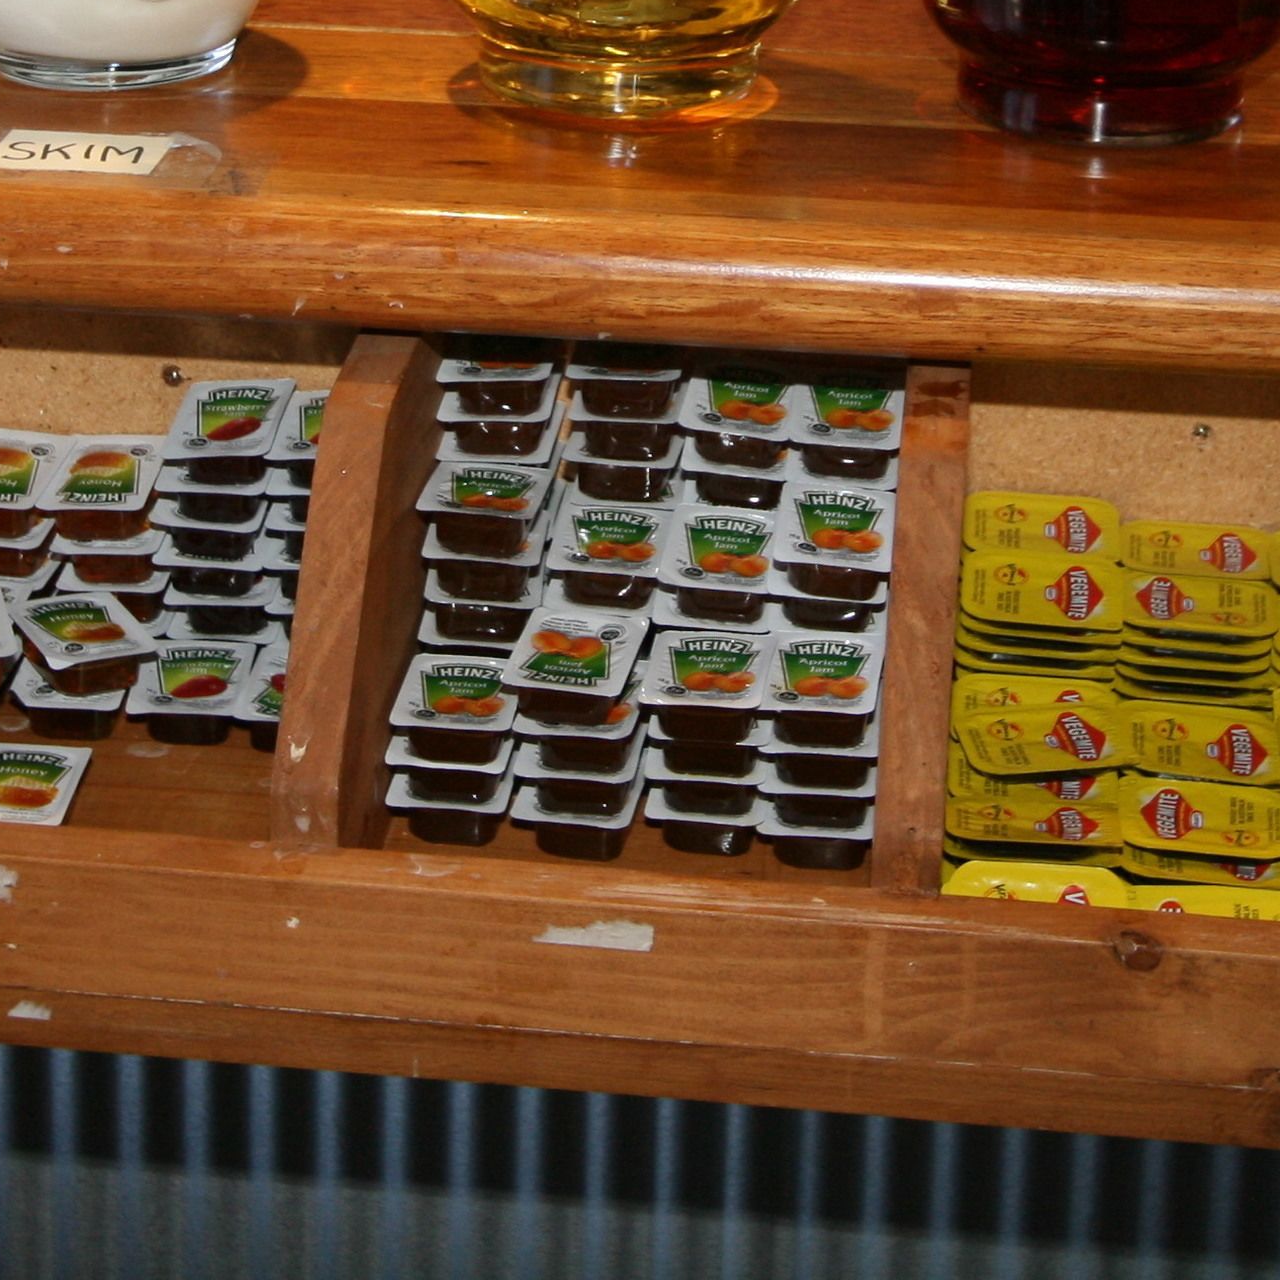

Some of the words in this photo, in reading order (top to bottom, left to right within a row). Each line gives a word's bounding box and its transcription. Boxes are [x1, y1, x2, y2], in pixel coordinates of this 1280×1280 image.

[1, 141, 145, 164] SKIM
[724, 381, 770, 393] Apricot
[216, 389, 266, 400] HEINZ
[733, 390, 757, 399] Jam
[828, 390, 873, 400] Apricot
[837, 398, 862, 406] Jam
[204, 404, 267, 412] Strawberry
[470, 471, 522, 482] HEINZ
[79, 479, 124, 488] Honey
[469, 479, 522, 490] Apricot
[69, 492, 122, 502] HEINZ
[812, 494, 868, 510] HEINZ
[591, 512, 644, 525] HEINZ
[814, 509, 861, 520] Apricot
[704, 519, 758, 534] HEINZ
[823, 518, 850, 526] Jam
[591, 524, 637, 535] Apricot
[601, 531, 624, 539] Jam
[1067, 510, 1087, 552] VEGEMITE
[704, 533, 751, 544] Apricot
[713, 541, 738, 550] Jam
[1068, 570, 1089, 618] VEGEMITE
[49, 611, 95, 622] Honey
[689, 640, 744, 653] HEINZ
[798, 644, 855, 658] HEINZ
[174, 650, 227, 658] HEINZ
[688, 654, 737, 664] Apricot
[799, 657, 848, 667] Apricot
[440, 667, 495, 679] HEINZ
[543, 664, 592, 674] Apricot
[810, 665, 835, 673] Jam
[439, 679, 488, 690] Apricot
[533, 673, 590, 685] HEINZ
[449, 687, 475, 695] Jam
[1061, 716, 1097, 759] VEGEMITE
[2, 751, 58, 764] HEINZ
[1230, 729, 1253, 775] VEGEMITE
[0, 765, 49, 777] Honey
[1156, 792, 1180, 838] VEGEMITE
